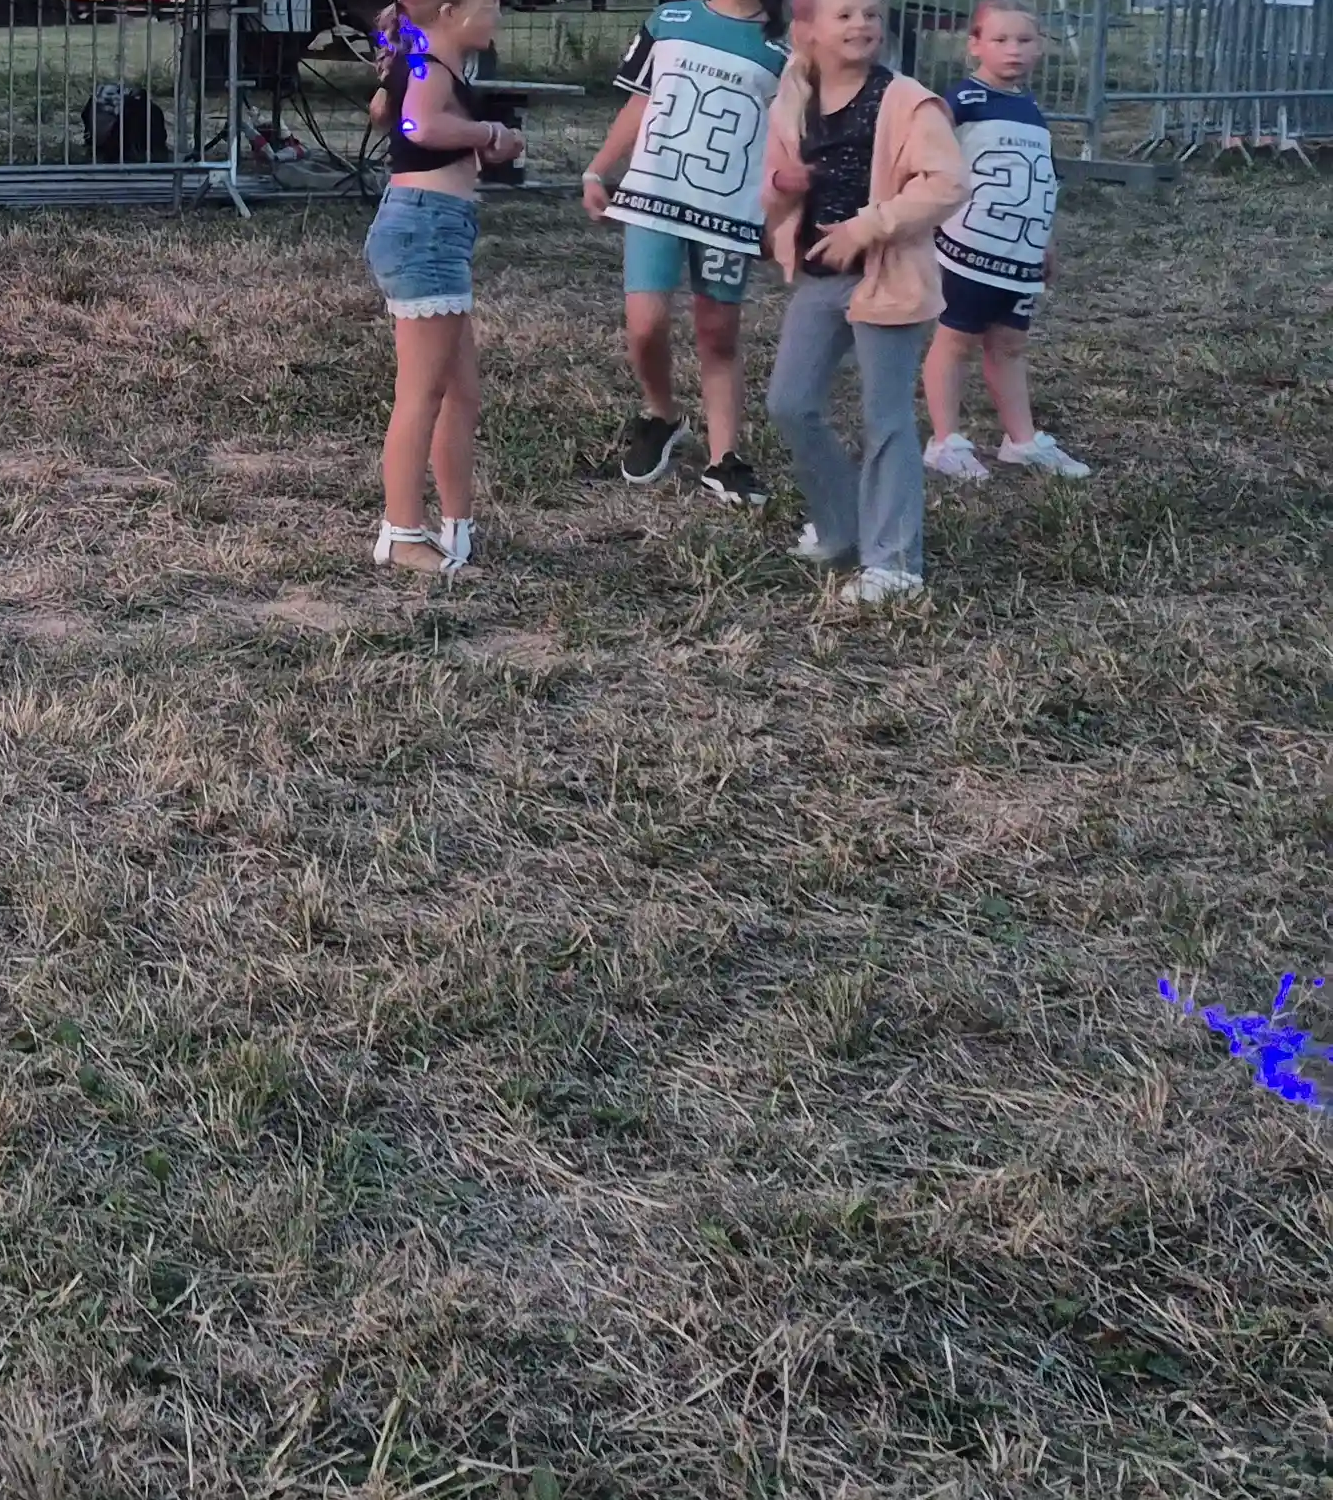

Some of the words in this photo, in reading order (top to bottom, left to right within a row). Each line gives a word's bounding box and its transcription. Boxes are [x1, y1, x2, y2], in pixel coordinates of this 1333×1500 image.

[630, 72, 760, 197] 23
[684, 209, 732, 232] STATE
[701, 248, 746, 286] 23
